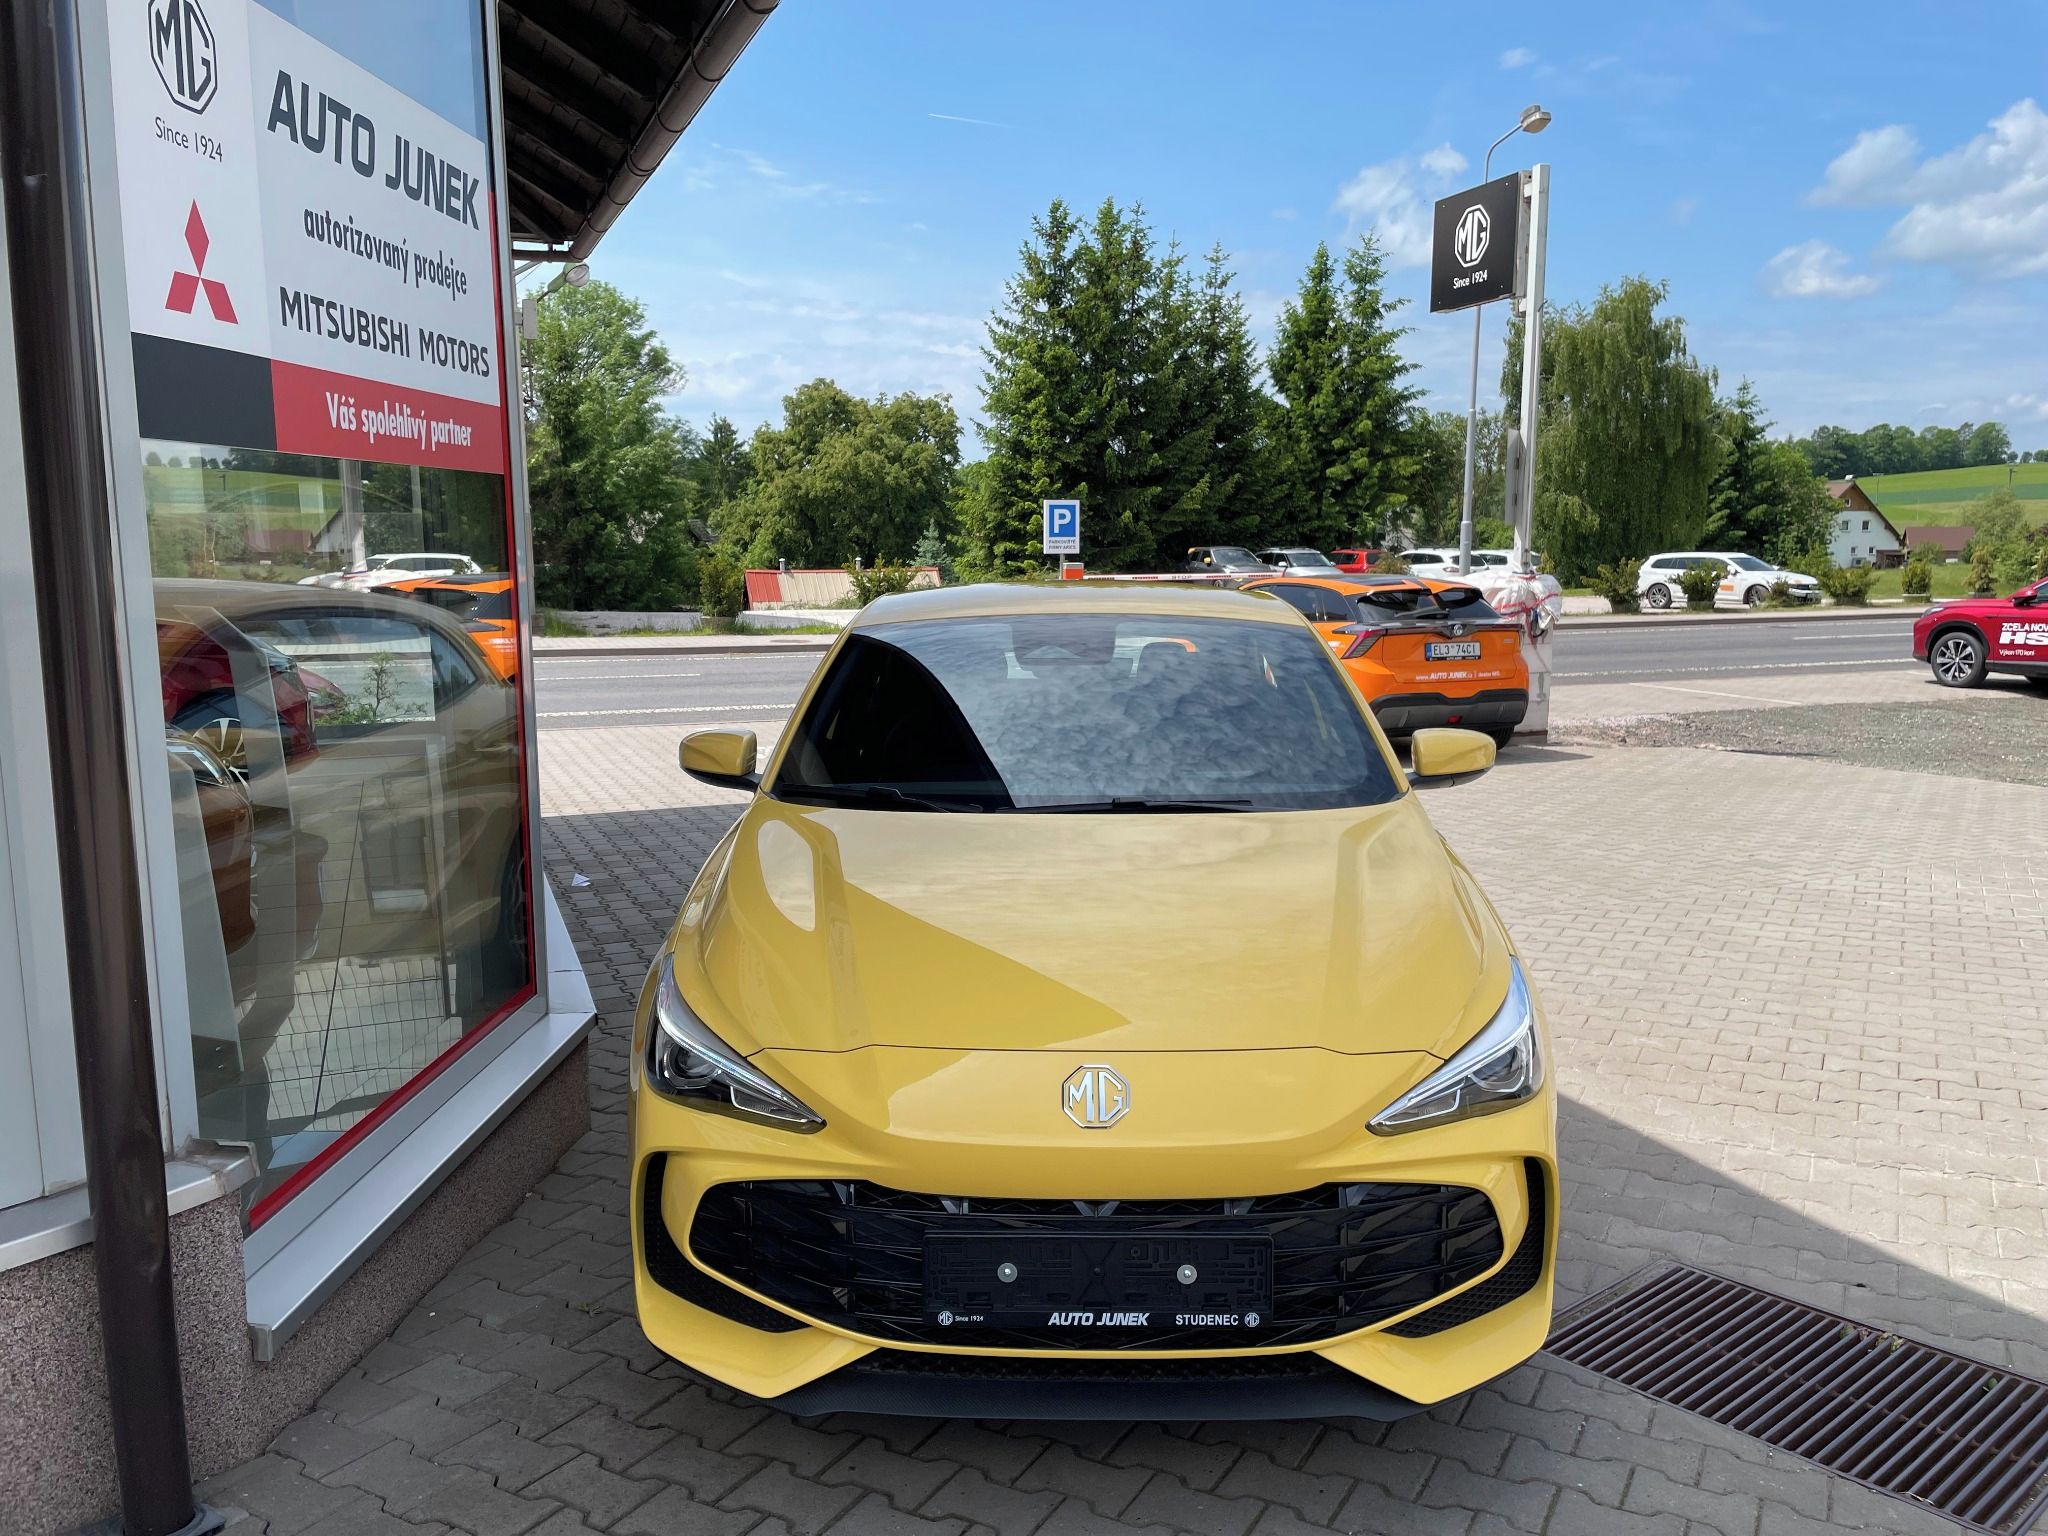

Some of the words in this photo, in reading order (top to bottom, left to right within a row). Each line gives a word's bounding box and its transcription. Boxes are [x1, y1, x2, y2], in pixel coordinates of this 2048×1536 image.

[153, 0, 212, 103] MG
[155, 117, 189, 150] Since
[193, 135, 223, 163] 1924
[267, 69, 376, 178] AUTO
[385, 133, 480, 230] JUNEK
[1457, 209, 1488, 262] MG
[303, 207, 409, 284] autorizovaný
[413, 248, 467, 301] prodejce
[1453, 277, 1470, 289] Since
[1471, 269, 1488, 285] 1924
[280, 286, 411, 358] MITSUBISHI
[418, 327, 490, 378] MOTORS
[325, 390, 357, 431] Váš
[361, 403, 427, 450] spolehlivý
[430, 418, 472, 452] partner
[1053, 508, 1072, 534] P
[1999, 632, 2048, 645] HS
[2001, 622, 2030, 631] ZCELA
[1433, 645, 1450, 656] EL3
[1067, 1070, 1124, 1124] MG
[938, 1311, 953, 1325] MG
[1047, 1312, 1094, 1326] AUTO
[1096, 1312, 1150, 1326] JUNEK
[1175, 1314, 1239, 1326] STUDENEC
[1245, 1313, 1259, 1327] MG
